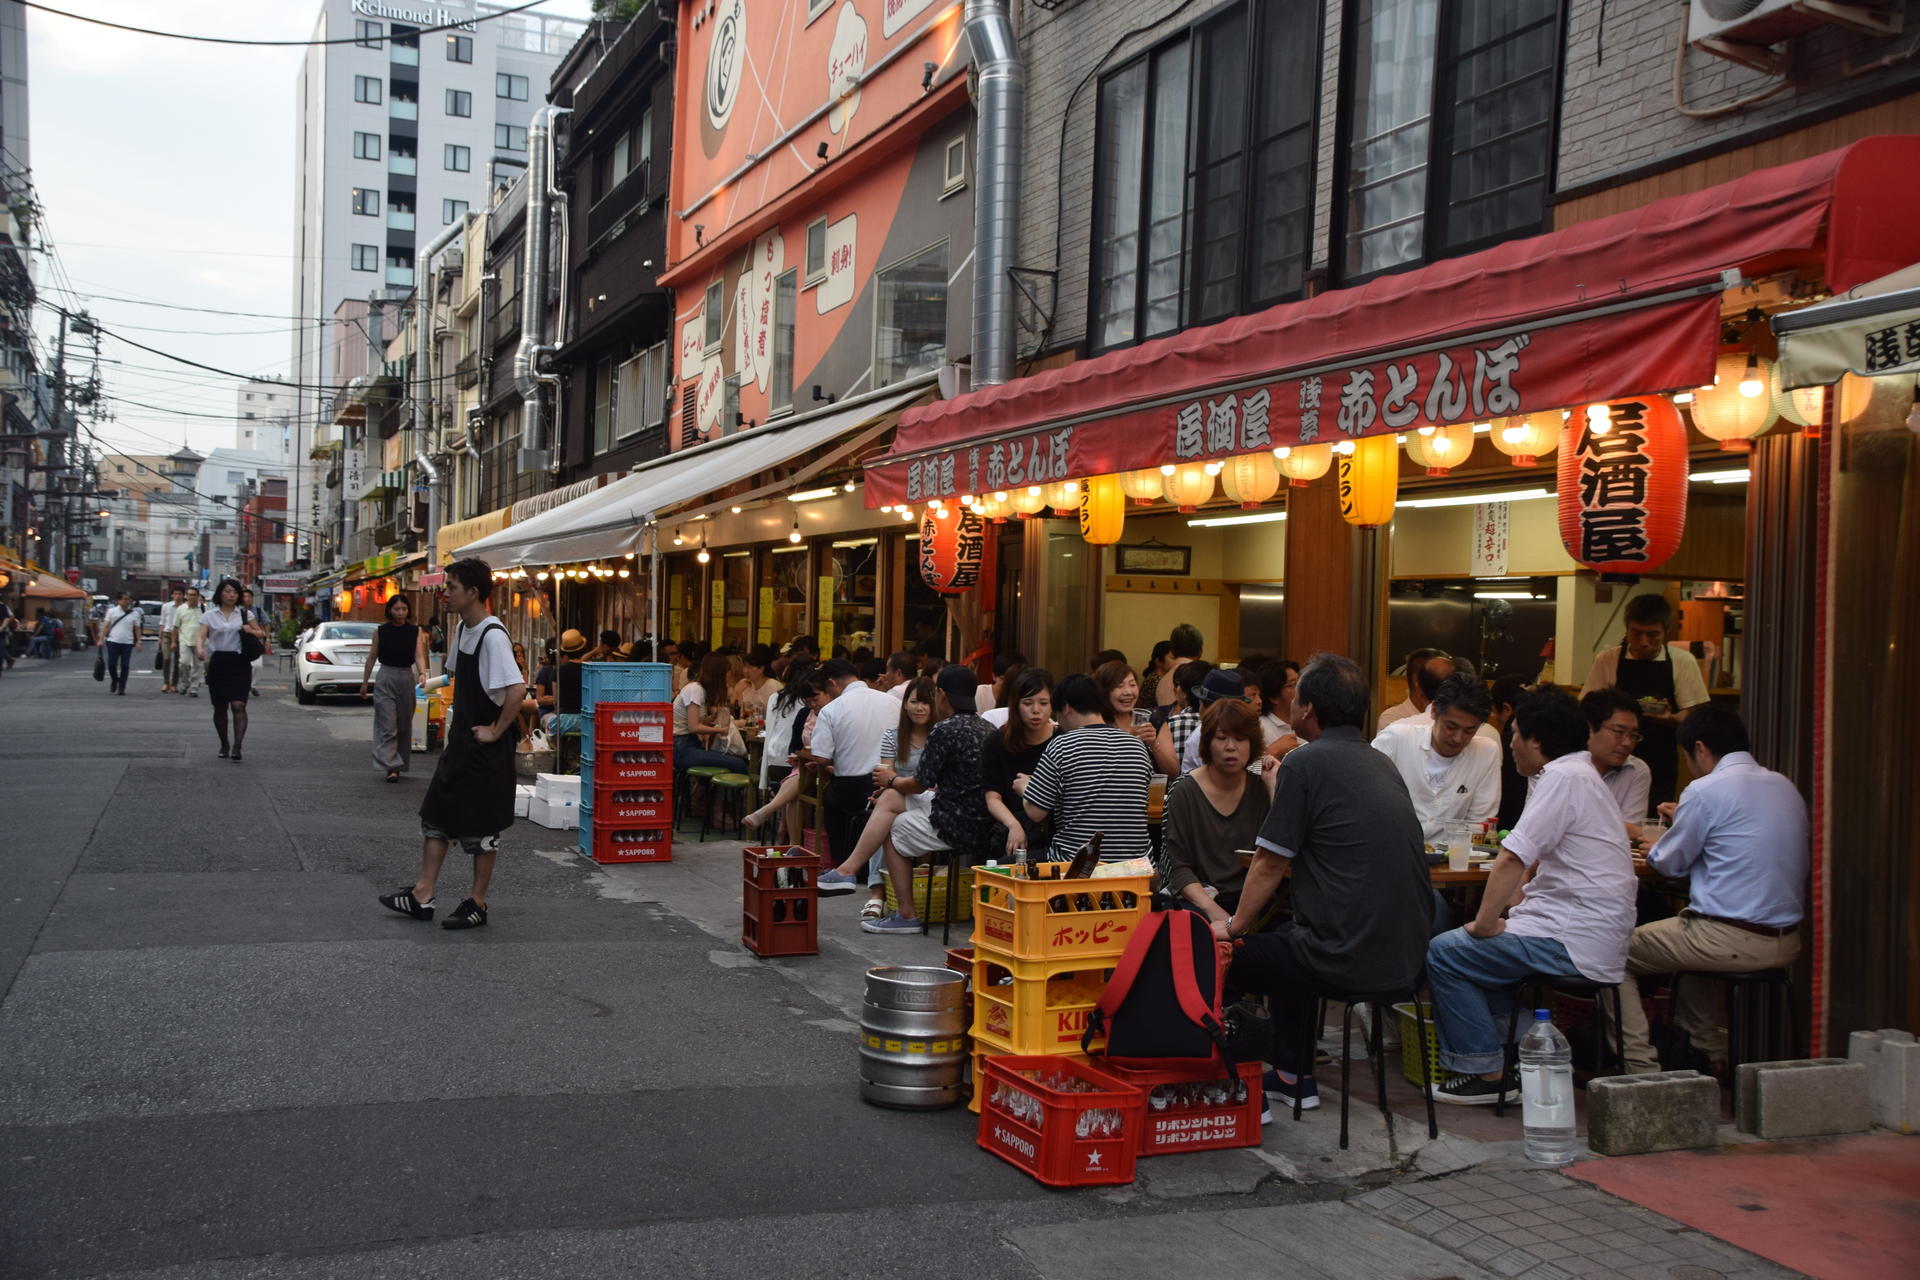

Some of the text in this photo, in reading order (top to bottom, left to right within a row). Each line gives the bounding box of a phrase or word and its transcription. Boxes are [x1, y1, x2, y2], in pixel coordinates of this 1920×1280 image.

[351, 0, 477, 33] Richmond Hotel
[832, 34, 866, 84] チューハイ
[683, 332, 703, 358] ビール
[1176, 333, 1531, 460] 居酒屋 浅草 赤とんぼ
[907, 454, 956, 501] 居酒屋
[986, 426, 1074, 490] 赤とんぼ
[1575, 400, 1651, 563] 居酒屋
[920, 517, 942, 587] 赤とんぼ
[948, 505, 985, 588] 居酒屋
[625, 809, 656, 817] SAPPORO
[624, 848, 655, 856] SAPPORO
[1052, 919, 1128, 947] ホッピー
[1155, 1113, 1237, 1132] リボンシトロン
[1155, 1127, 1237, 1145] リボンオレンジ
[1001, 1128, 1035, 1159] SAPPORO
